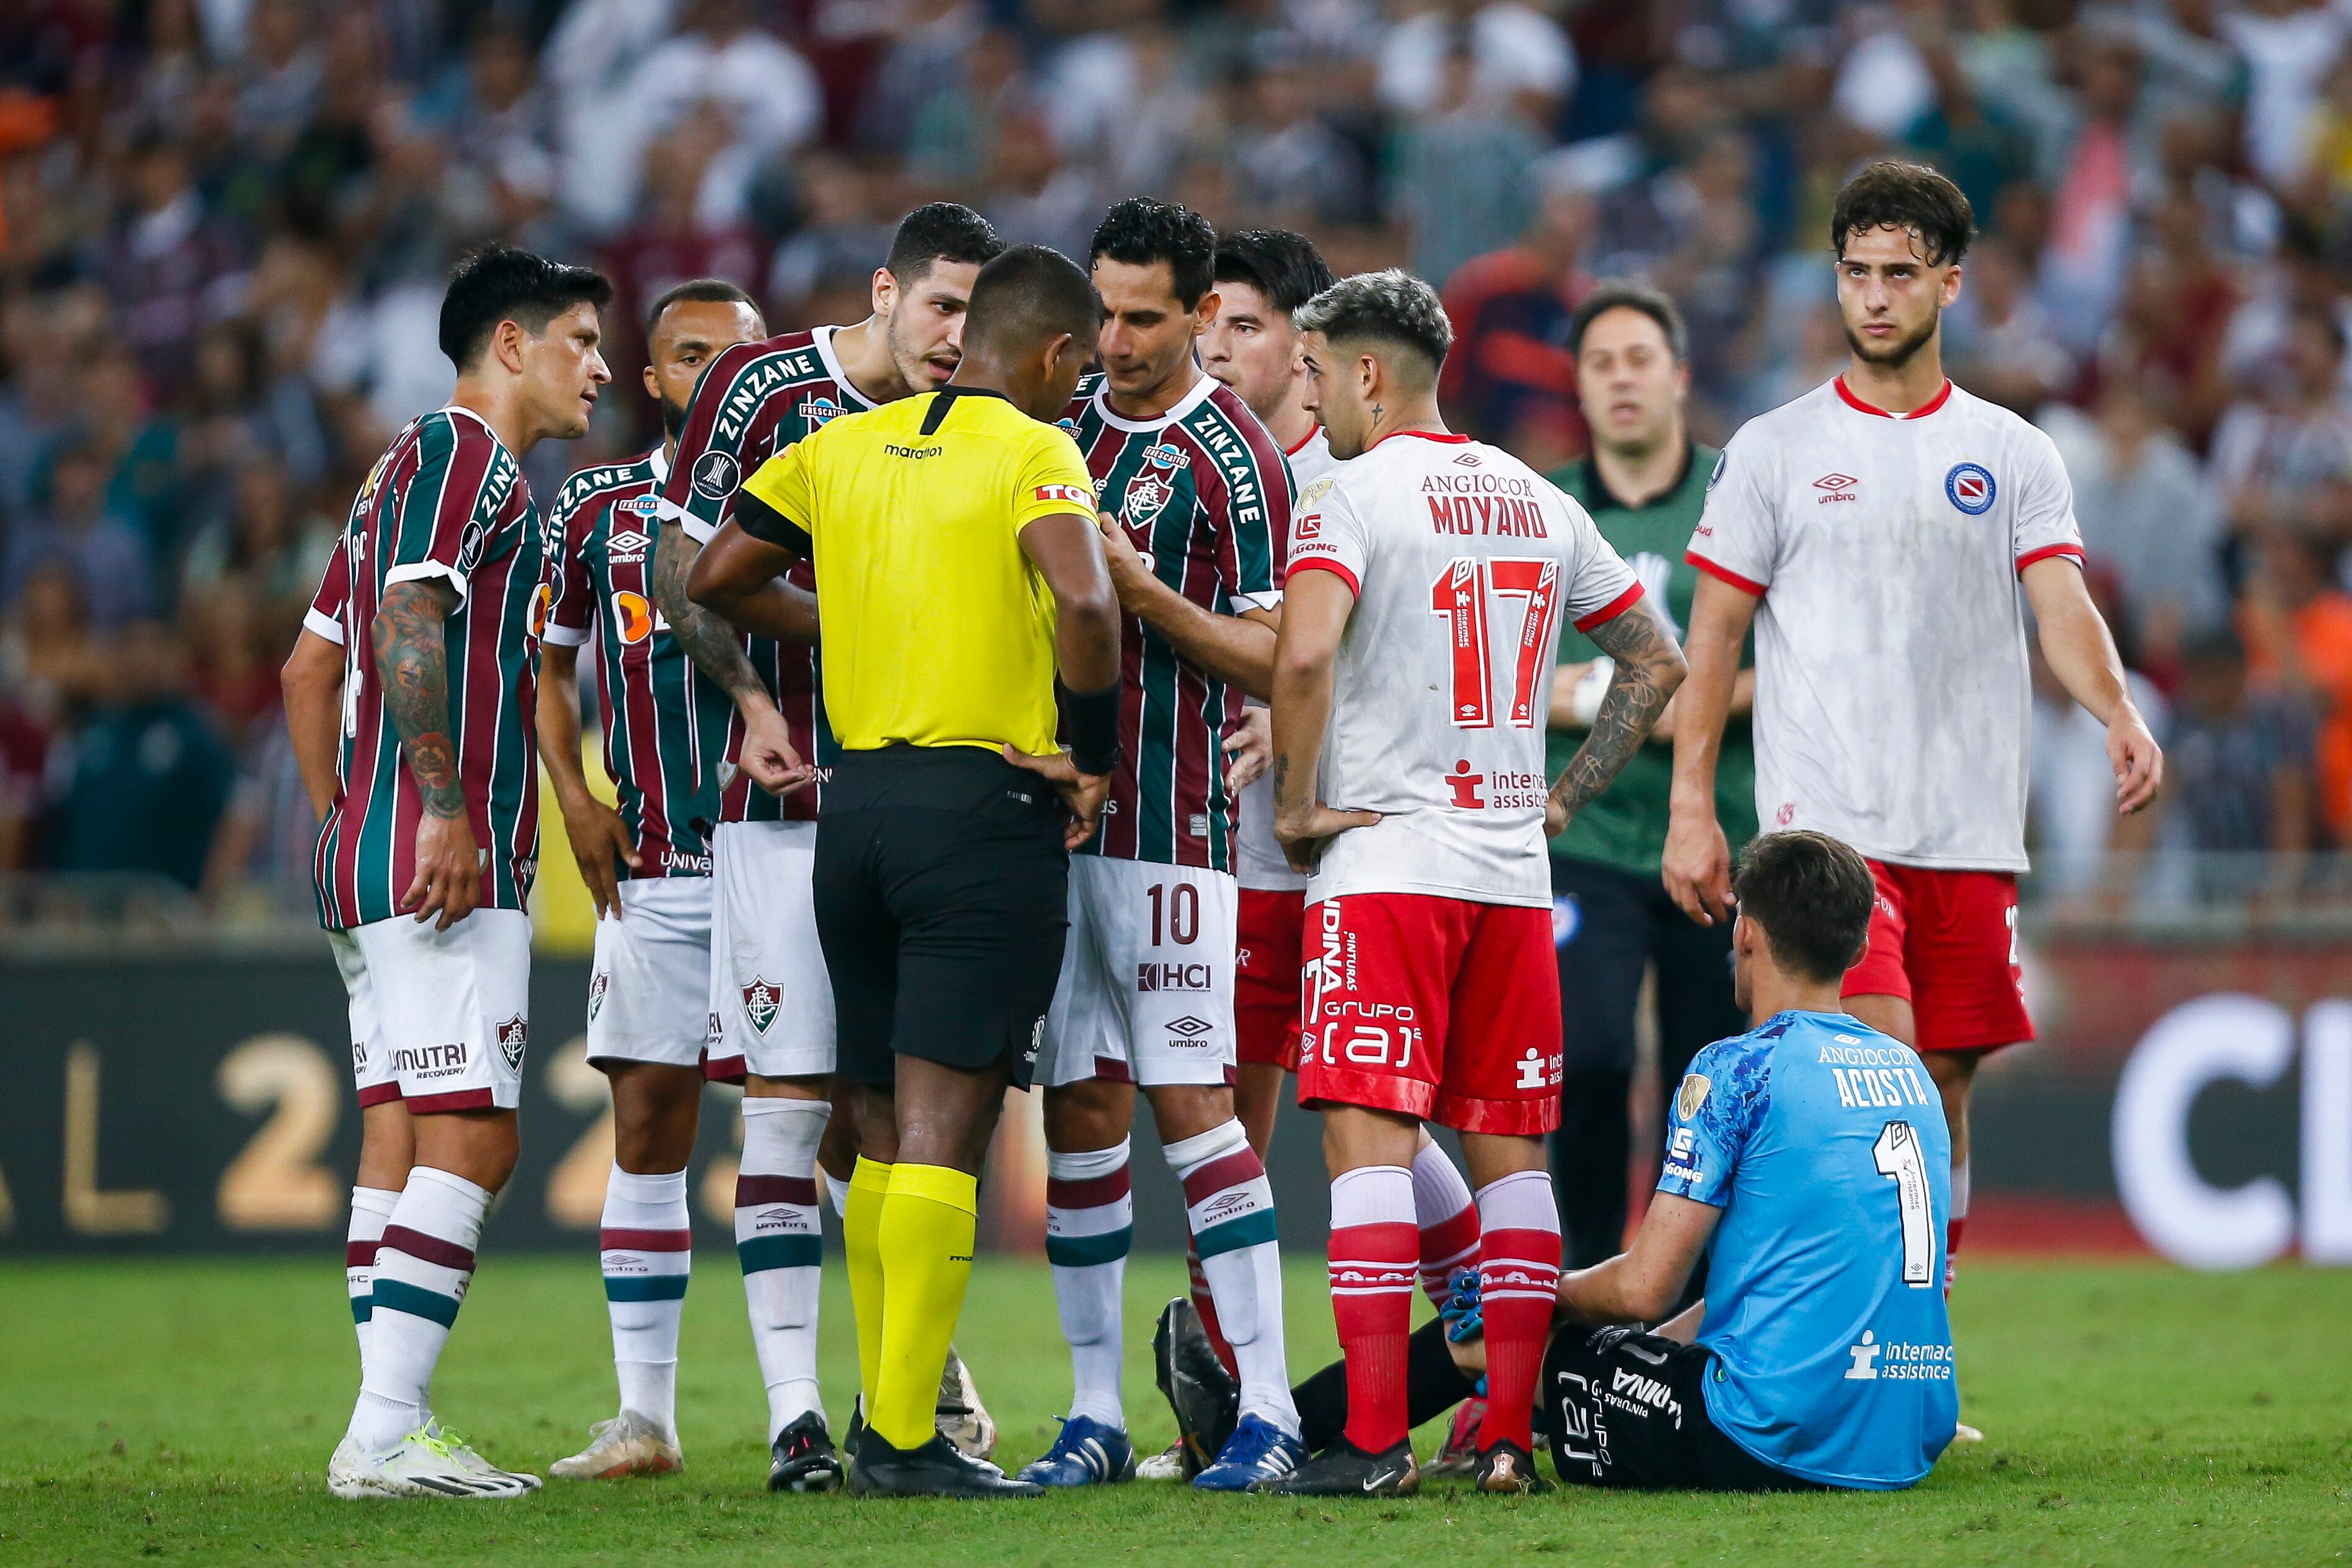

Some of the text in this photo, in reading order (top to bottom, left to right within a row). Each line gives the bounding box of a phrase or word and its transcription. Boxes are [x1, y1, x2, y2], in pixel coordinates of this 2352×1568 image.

[718, 354, 815, 442] ZINZANE
[1146, 448, 1187, 466] FRESCATTO
[1193, 412, 1261, 524] ZINZANE
[1420, 474, 1535, 497] ANGIOCOR
[1817, 493, 1856, 504] umbro
[1427, 496, 1548, 538] MOYANO
[608, 553, 646, 564] umbro
[1429, 556, 1561, 729] 17
[1147, 883, 1199, 947] 10
[1163, 963, 1211, 988] HCI
[1169, 1038, 1208, 1048] umbro
[1817, 1045, 1915, 1066] ANGIOCOR
[416, 1066, 466, 1080] RECOVERY
[1832, 1067, 1929, 1107] ACOSTA
[1205, 1200, 1255, 1224] umbro
[1871, 1120, 1936, 1288] 1
